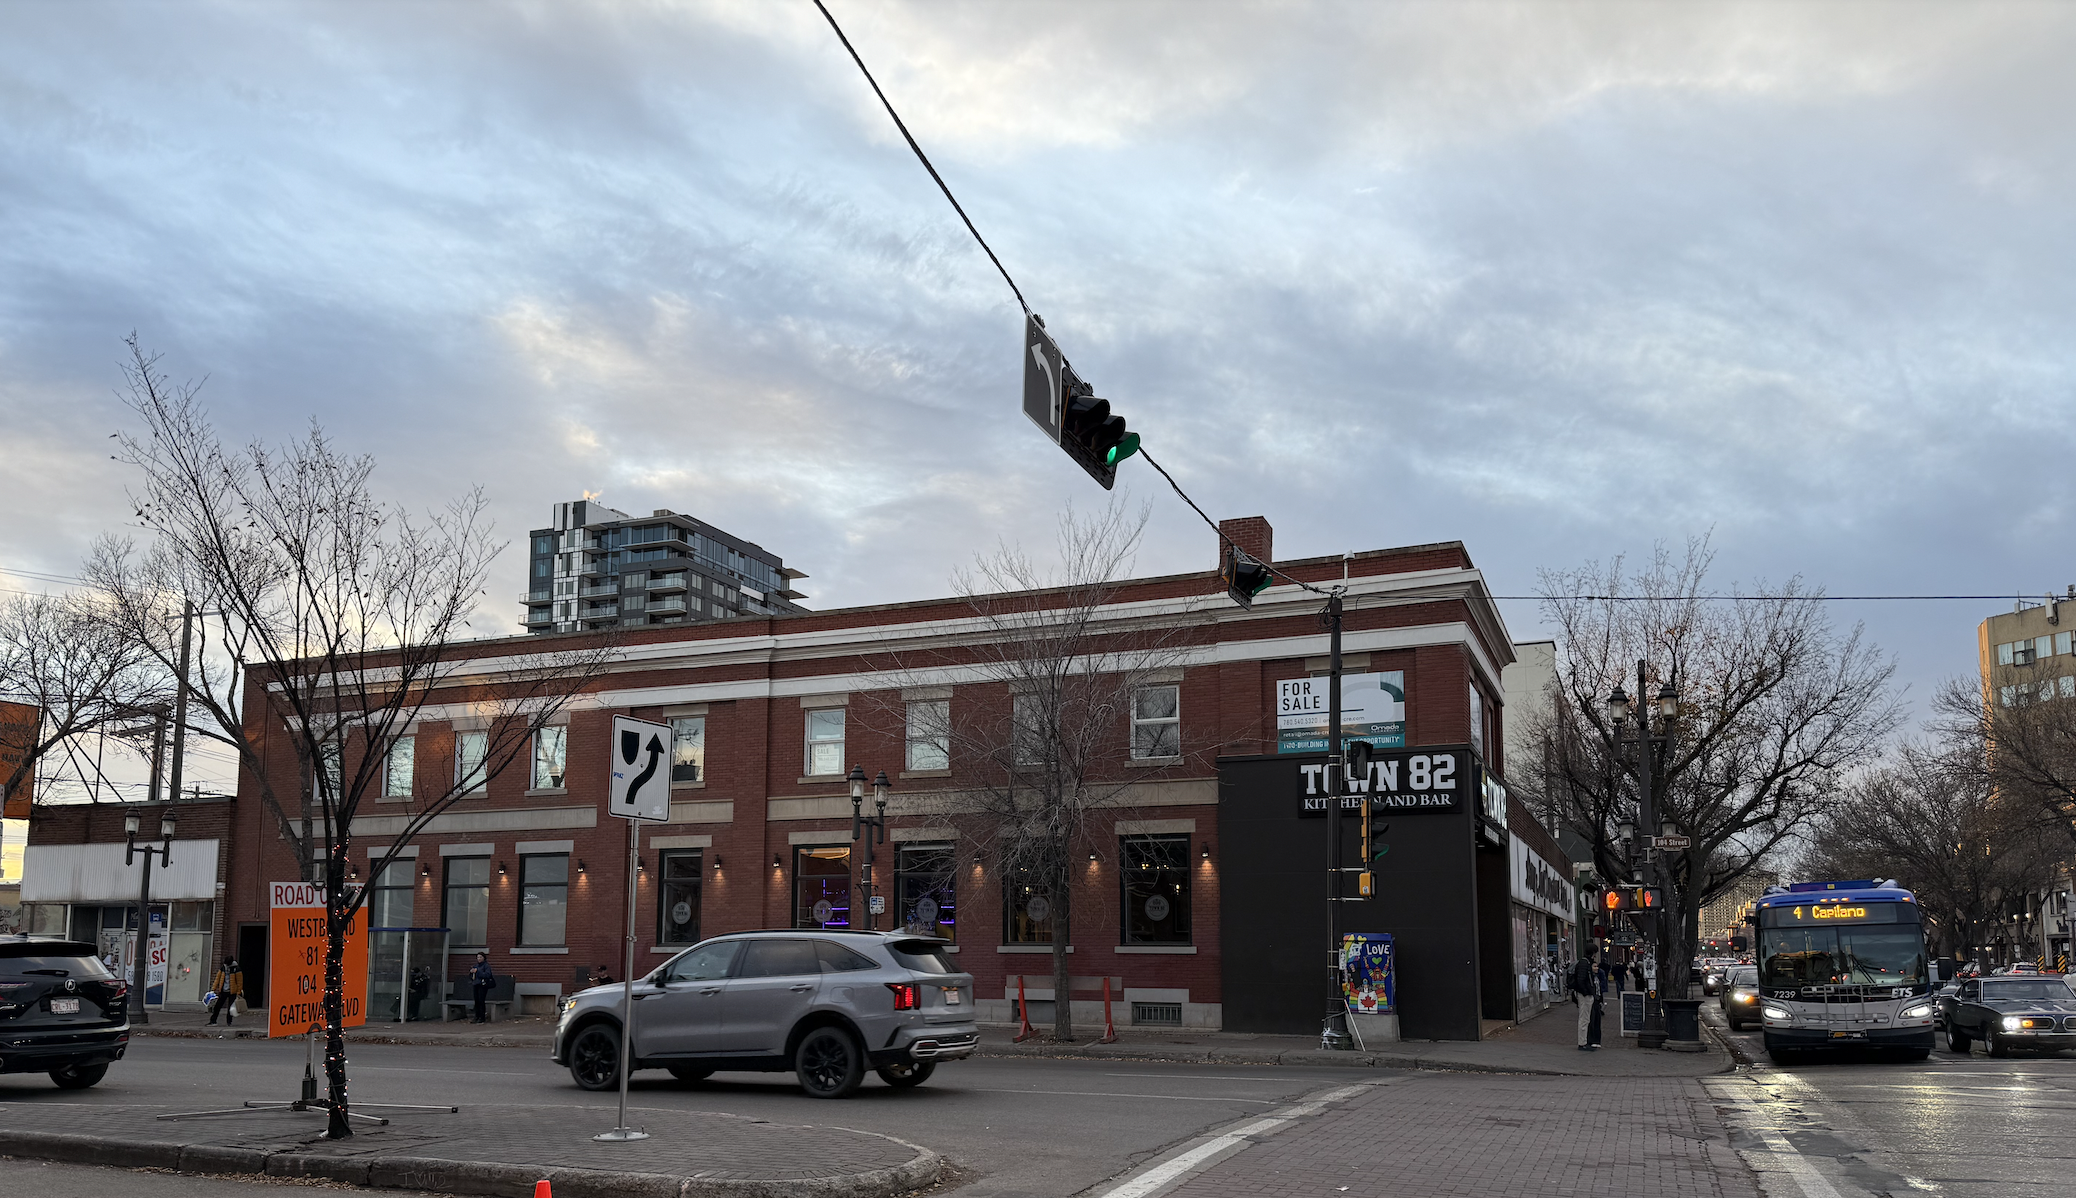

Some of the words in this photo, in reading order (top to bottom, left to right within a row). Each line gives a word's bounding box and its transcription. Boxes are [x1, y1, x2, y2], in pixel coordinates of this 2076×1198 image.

[1283, 682, 1311, 696] FOR
[1283, 696, 1320, 711] SALE
[1301, 761, 1399, 794] TWN
[1408, 754, 1456, 791] 82
[1304, 795, 1381, 810] KITHEN
[1385, 795, 1416, 807] AND
[1420, 793, 1452, 806] BAR
[275, 885, 314, 905] ROAD
[1793, 906, 1802, 920] 4
[1812, 905, 1866, 919] Capilano
[288, 918, 355, 938] WESTBD
[306, 946, 318, 966] 81
[1366, 944, 1390, 955] LOVE
[297, 974, 317, 995] 104
[1891, 988, 1913, 998] ETS
[1774, 991, 1796, 999] 7239
[279, 1001, 327, 1026] GATEWA
[342, 997, 359, 1018] LVD
